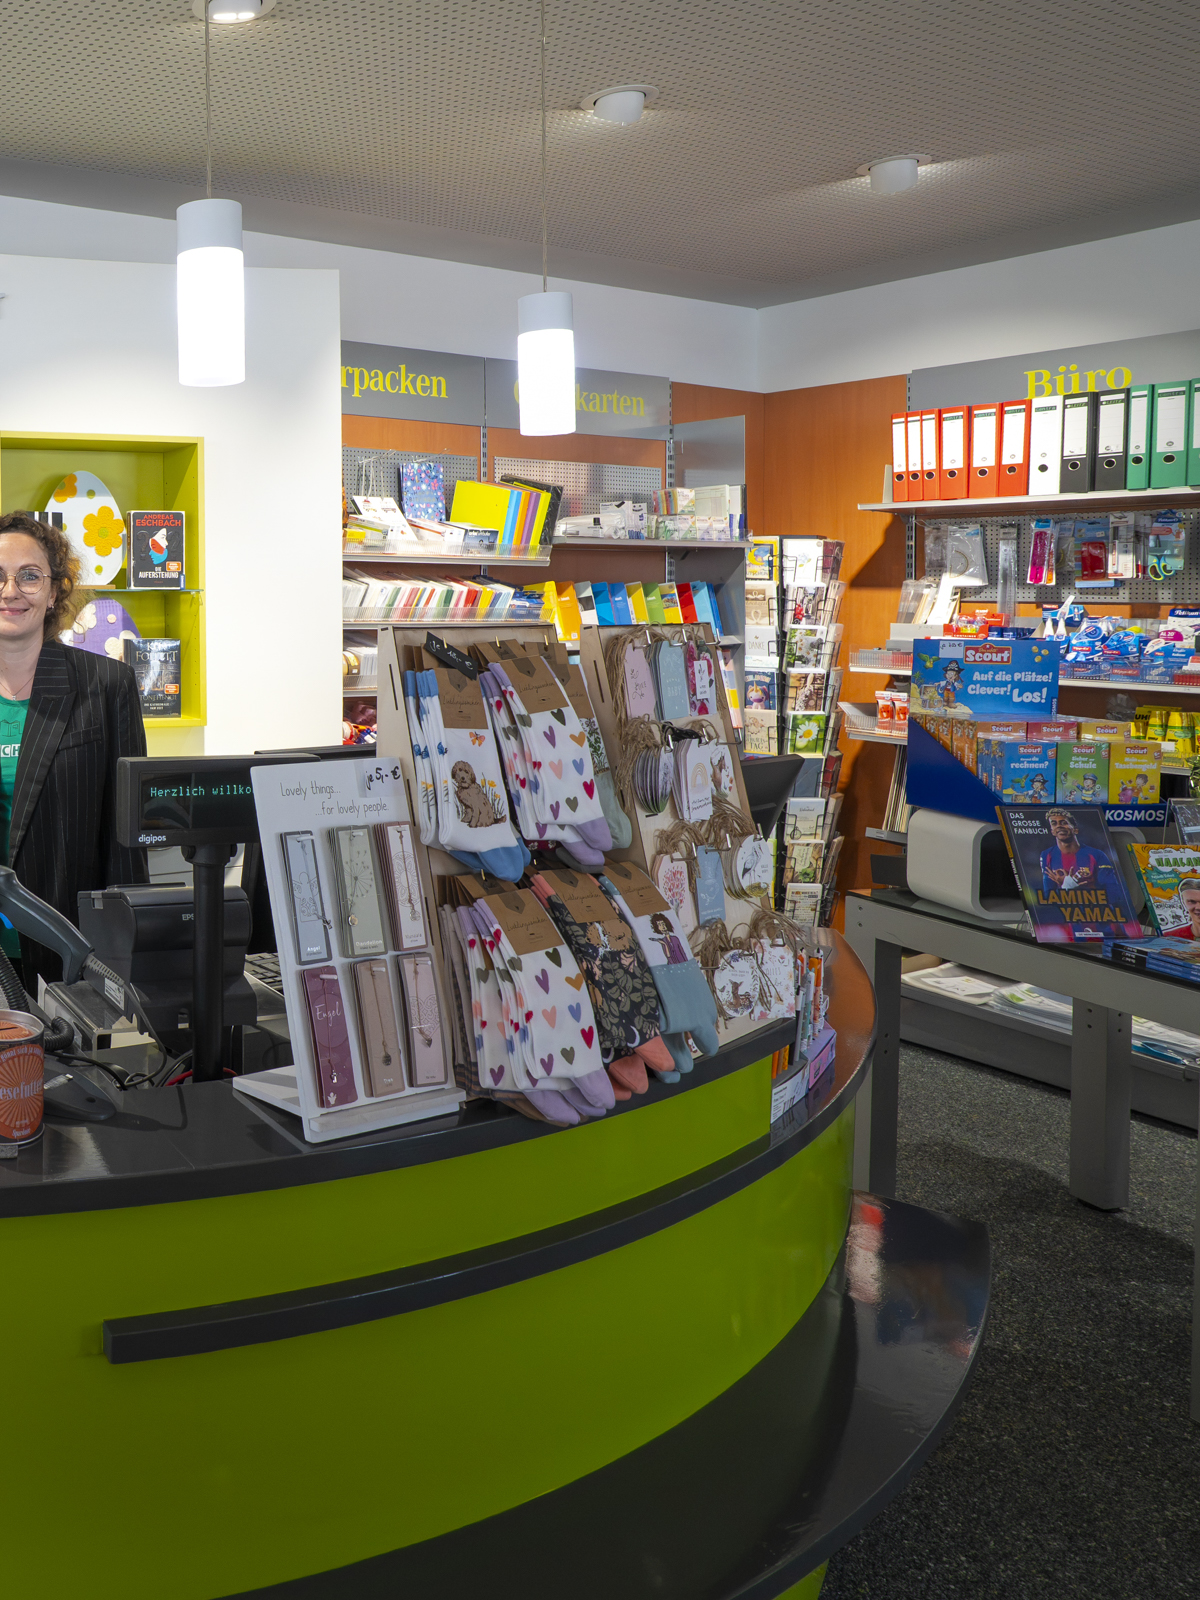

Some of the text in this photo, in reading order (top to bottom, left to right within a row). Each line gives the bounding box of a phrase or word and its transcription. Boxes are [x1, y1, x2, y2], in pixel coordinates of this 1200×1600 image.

[341, 363, 448, 398] rpacken
[1024, 364, 1132, 400] Büro
[136, 519, 182, 527] ESCHBACH
[965, 650, 1010, 662] Scout
[973, 671, 1053, 682] Auf die Plätze!
[968, 684, 1048, 703] Clever! Los!
[366, 770, 374, 790] je
[391, 766, 400, 780] €
[150, 784, 254, 797] Herzlich willko
[280, 781, 341, 800] Lovely things...
[336, 801, 360, 818] lovely
[363, 798, 390, 817] people.
[1105, 810, 1165, 822] KOSMOS
[138, 834, 166, 844] digipos
[1155, 857, 1200, 868] HAALAN
[1036, 889, 1108, 905] LAMINE
[1061, 908, 1126, 922] YAMAL
[315, 1001, 342, 1026] Engel
